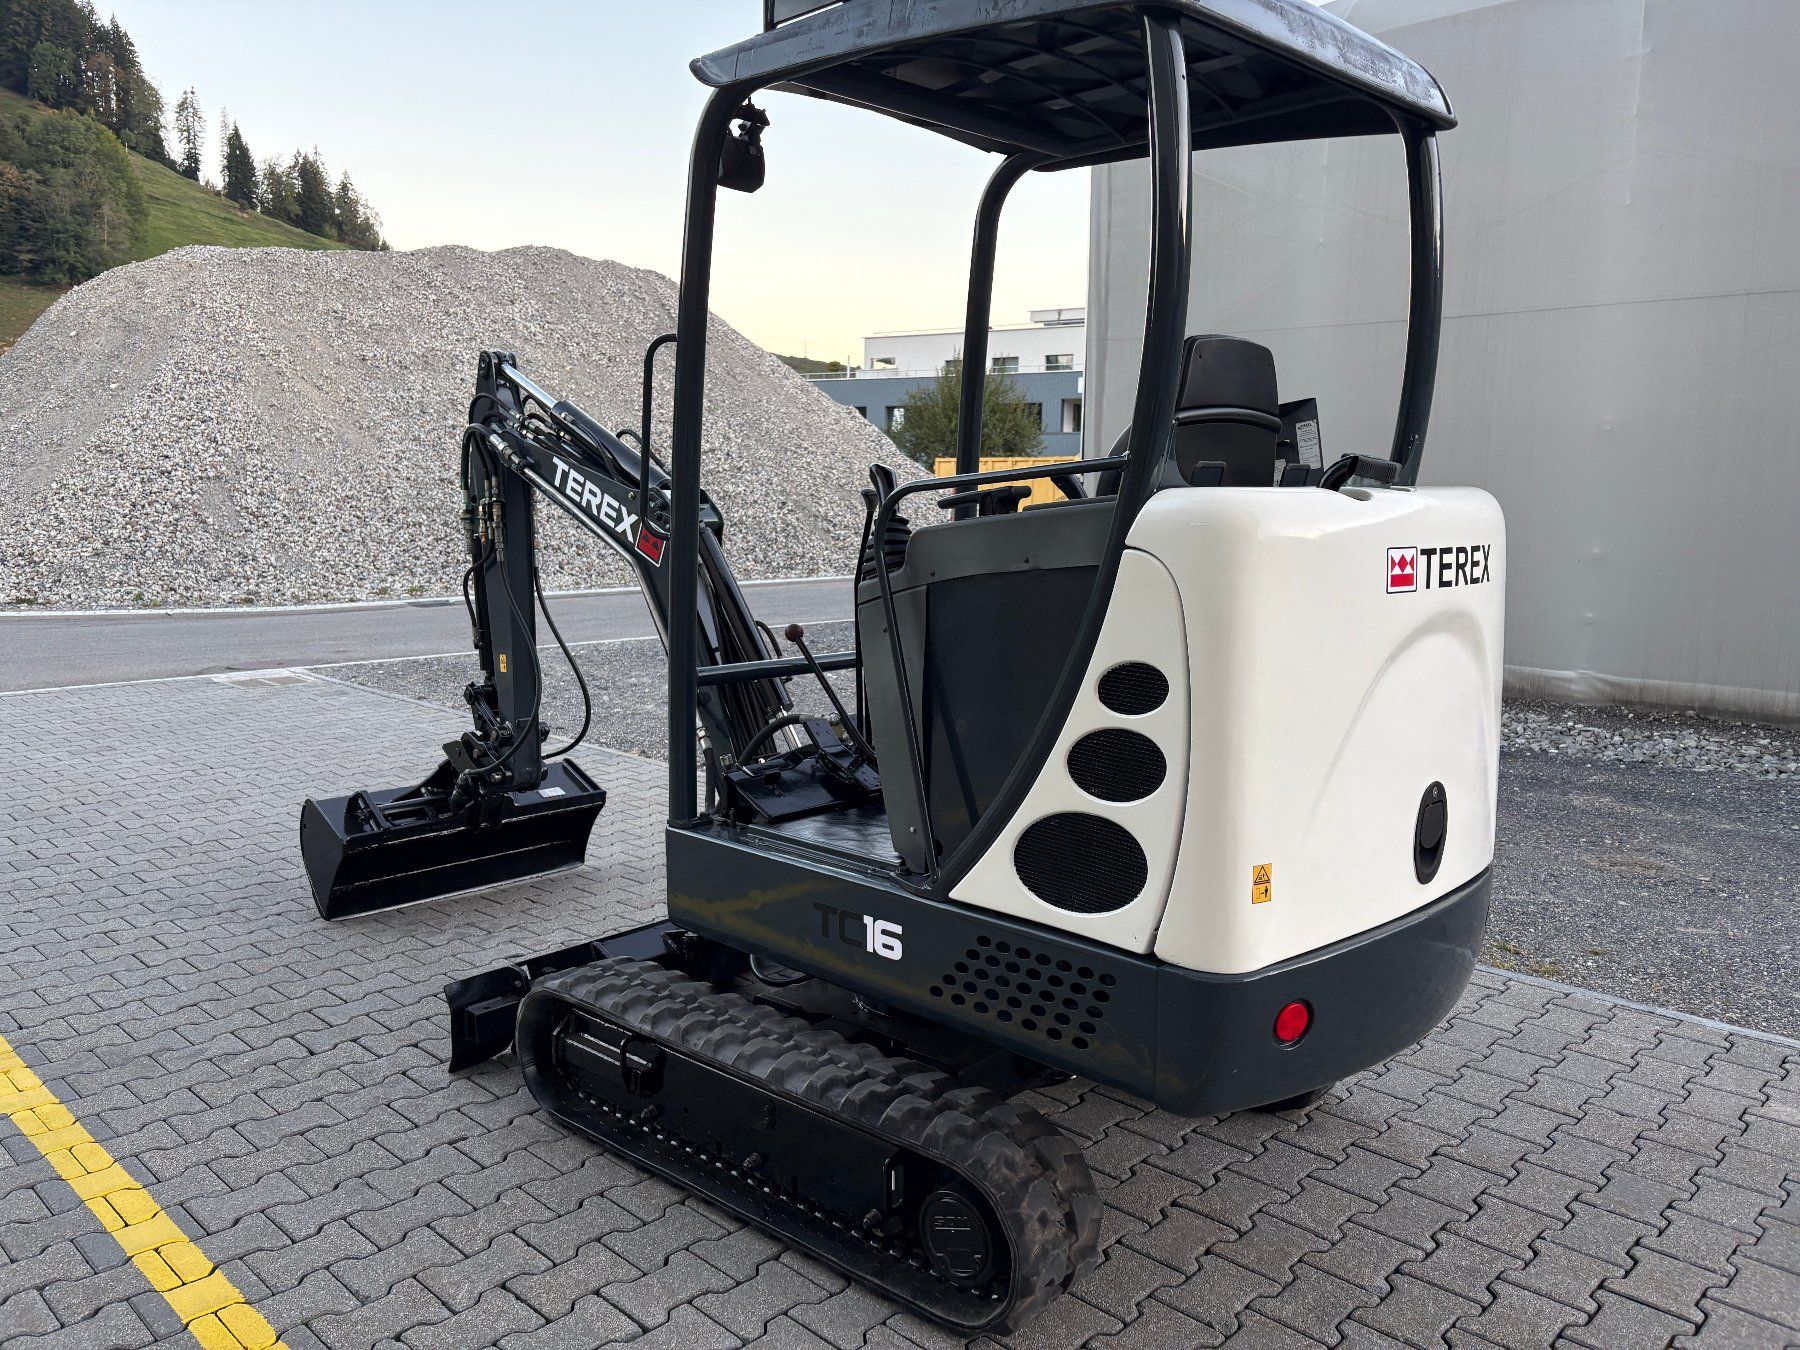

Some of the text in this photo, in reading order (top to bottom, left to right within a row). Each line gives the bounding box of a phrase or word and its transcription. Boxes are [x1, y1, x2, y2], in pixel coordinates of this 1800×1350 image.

[552, 455, 639, 544] TEREX
[1420, 544, 1491, 590] TEREX
[813, 901, 903, 961] TC16
